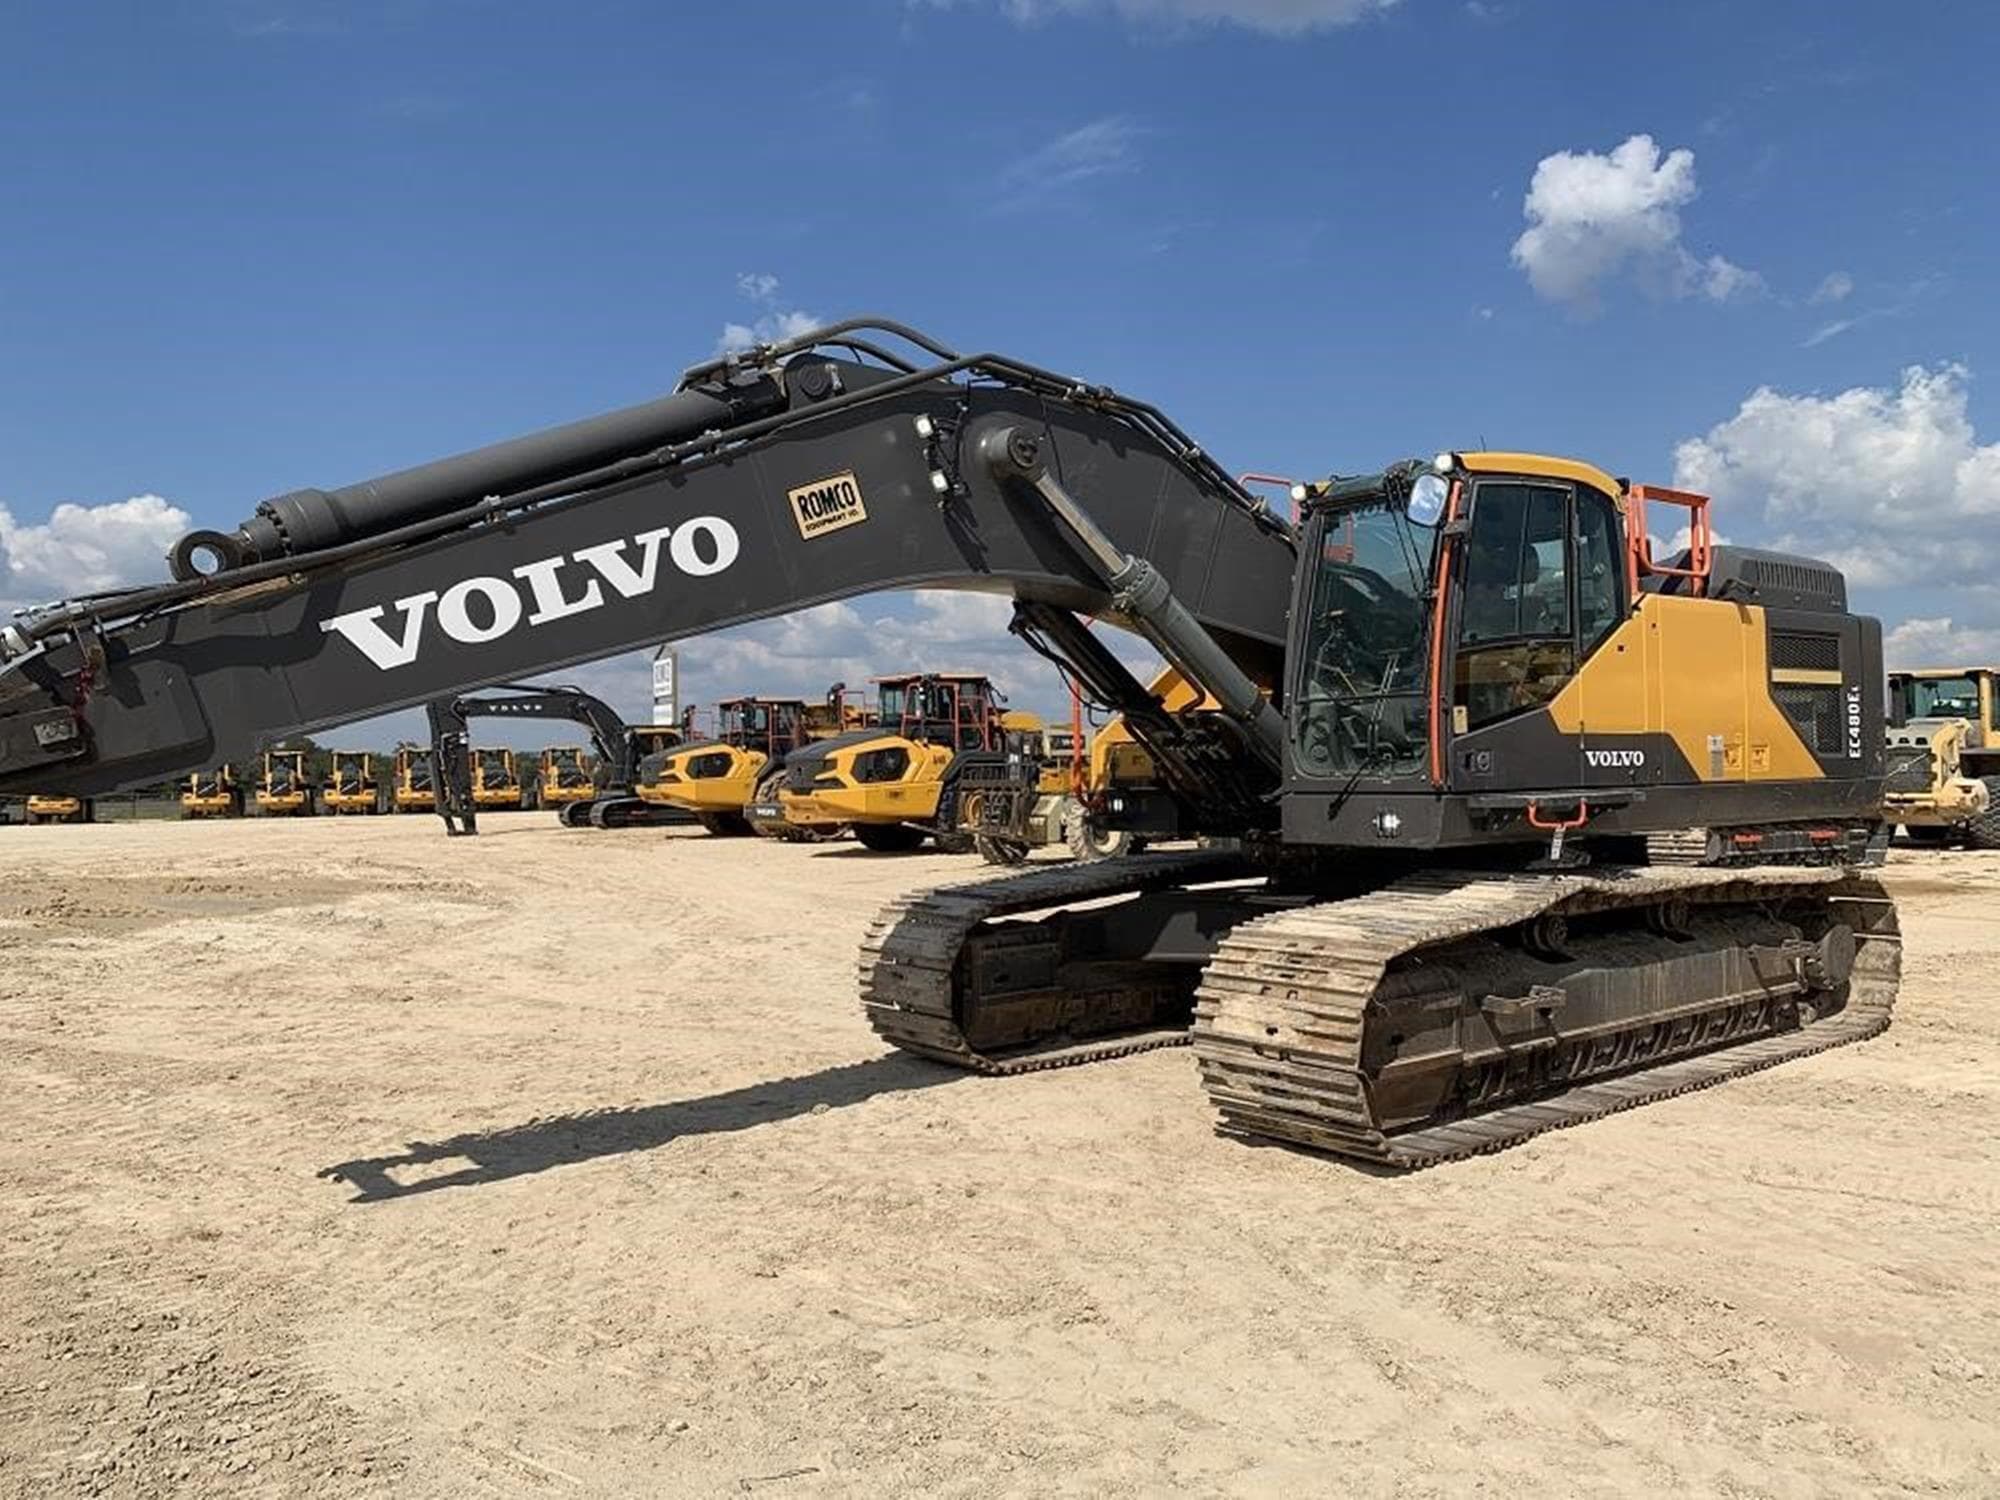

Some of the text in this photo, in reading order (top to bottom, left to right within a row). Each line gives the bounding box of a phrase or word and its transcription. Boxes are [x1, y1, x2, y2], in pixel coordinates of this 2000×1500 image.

[797, 481, 856, 521] ROMCO
[319, 515, 740, 671] VOLVO
[1585, 751, 1645, 767] VOLVO
